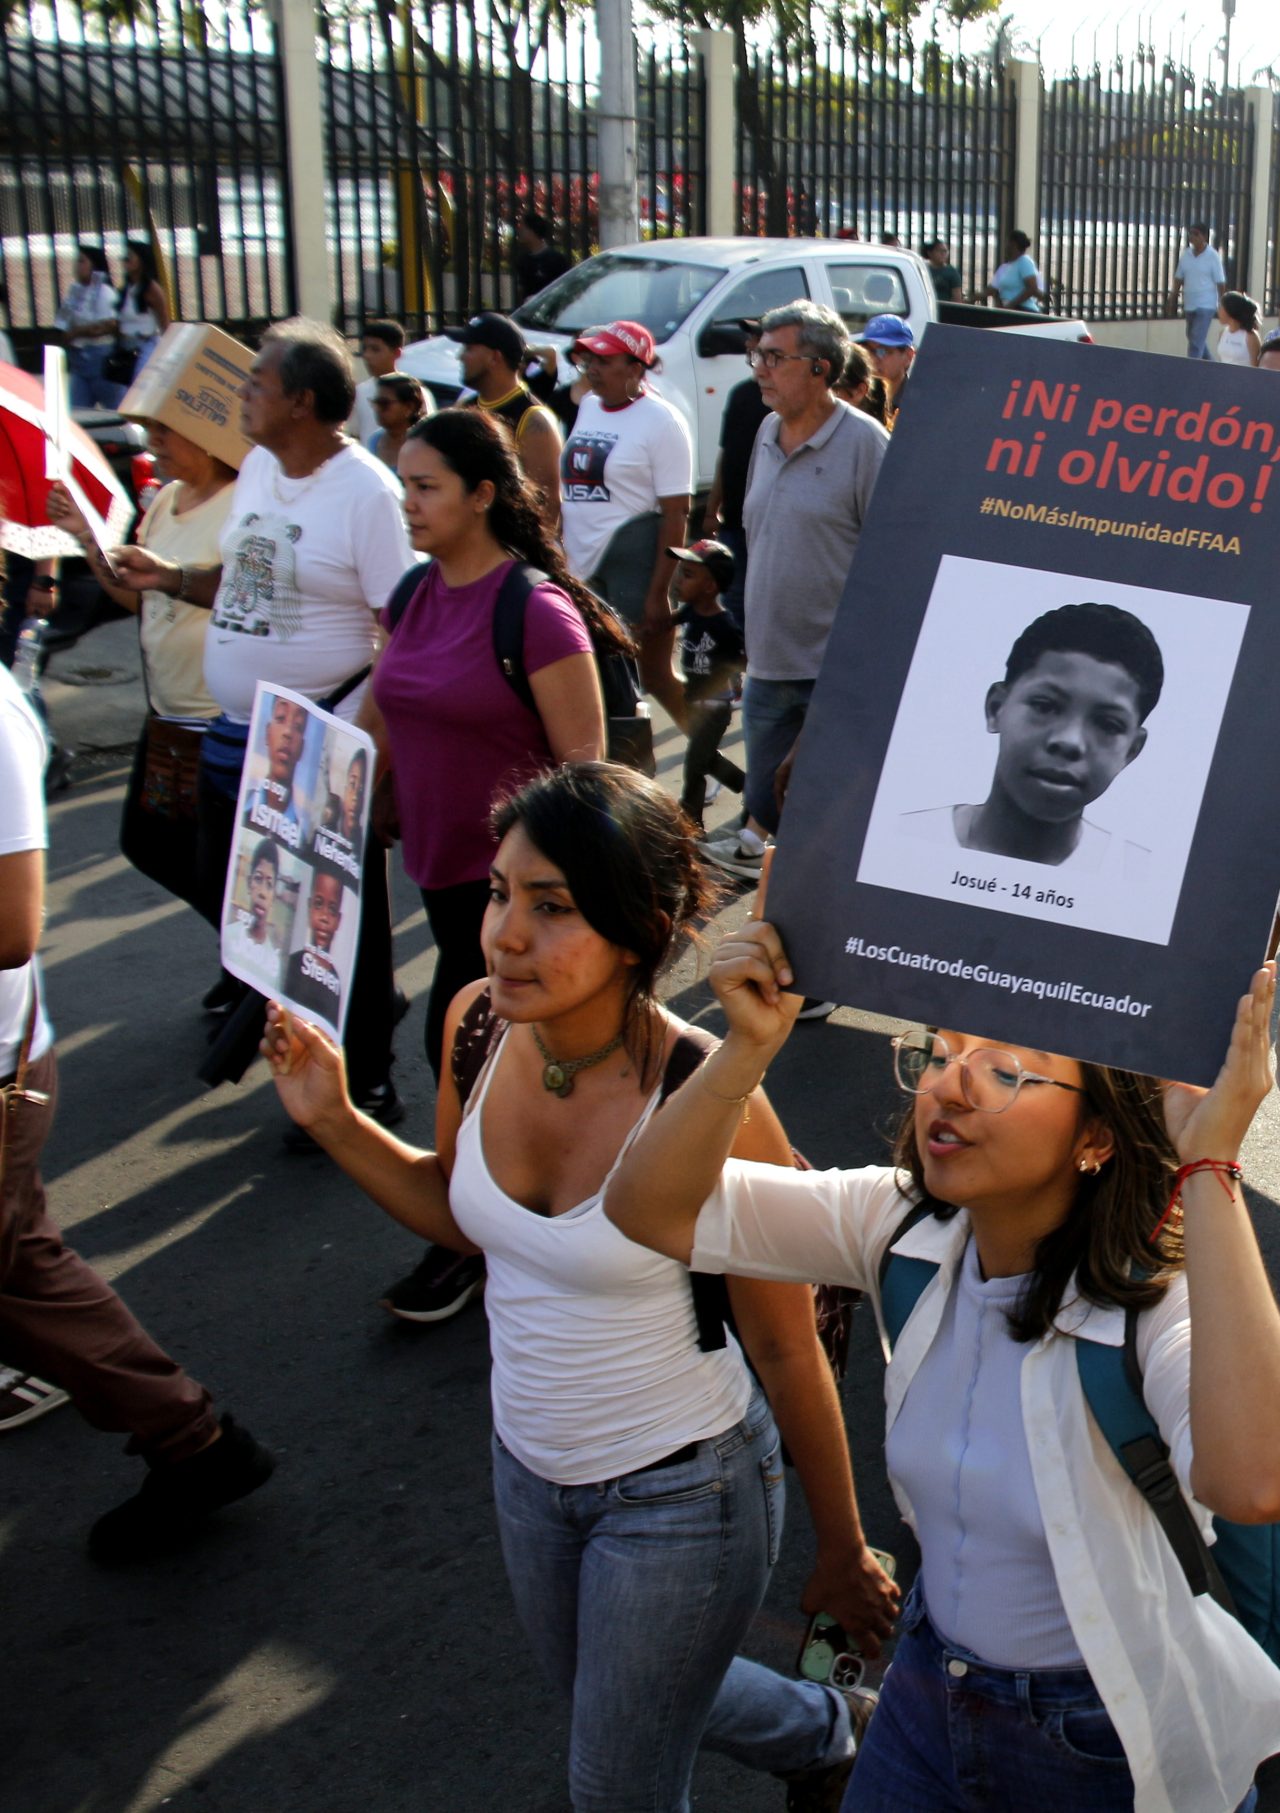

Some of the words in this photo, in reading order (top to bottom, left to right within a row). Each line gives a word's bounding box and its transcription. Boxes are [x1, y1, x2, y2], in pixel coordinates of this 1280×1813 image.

[1002, 378, 1080, 424] ¡Ni
[985, 431, 1046, 479] ni
[1058, 441, 1275, 515] olvido!
[980, 497, 1242, 556] #NoMásImpunidadFFAA
[951, 871, 997, 893] Josué
[1011, 882, 1031, 900] 14
[1035, 888, 1075, 909] años
[844, 937, 1152, 1018] #LosCuatrodeGuayaquilEcuador
